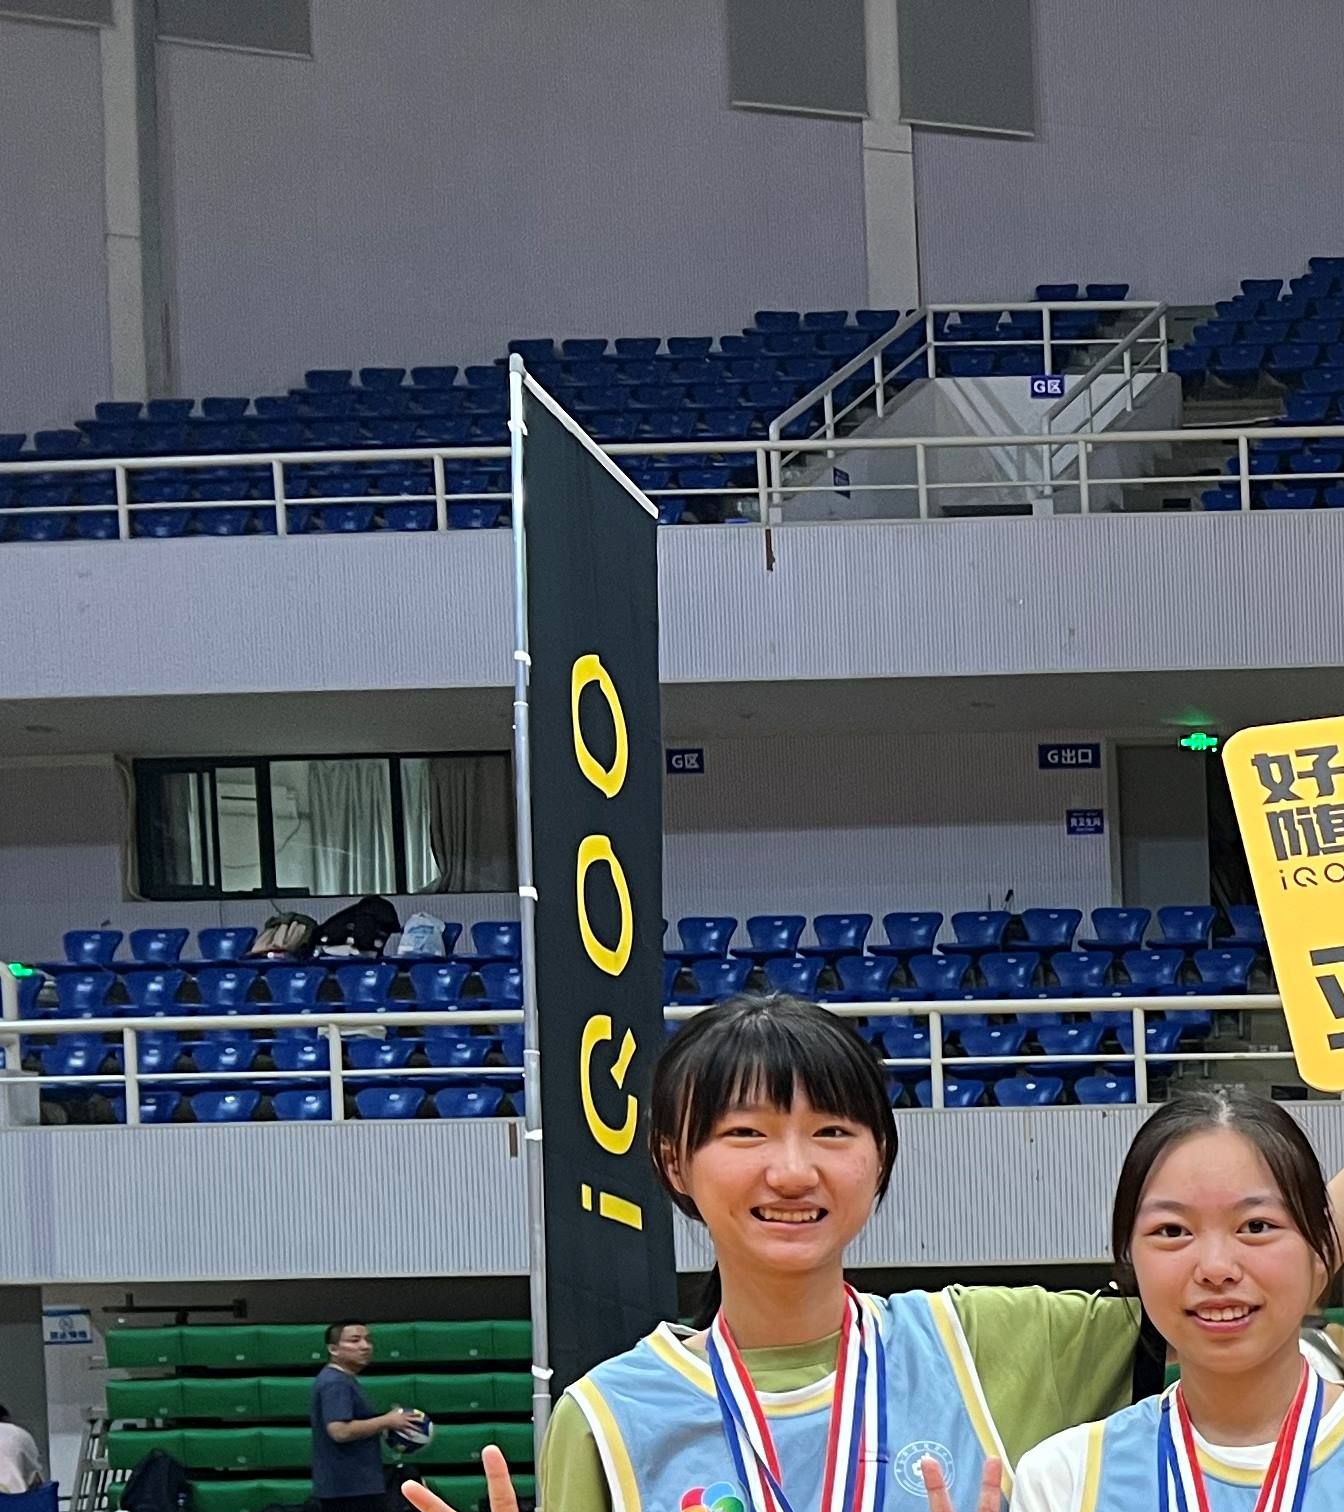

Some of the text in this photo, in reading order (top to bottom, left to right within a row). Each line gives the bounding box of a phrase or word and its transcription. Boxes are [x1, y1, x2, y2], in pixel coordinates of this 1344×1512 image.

[1034, 380, 1062, 394] G区
[671, 753, 700, 768] G区
[1047, 748, 1092, 764] G出口
[571, 654, 642, 1231] iQOO
